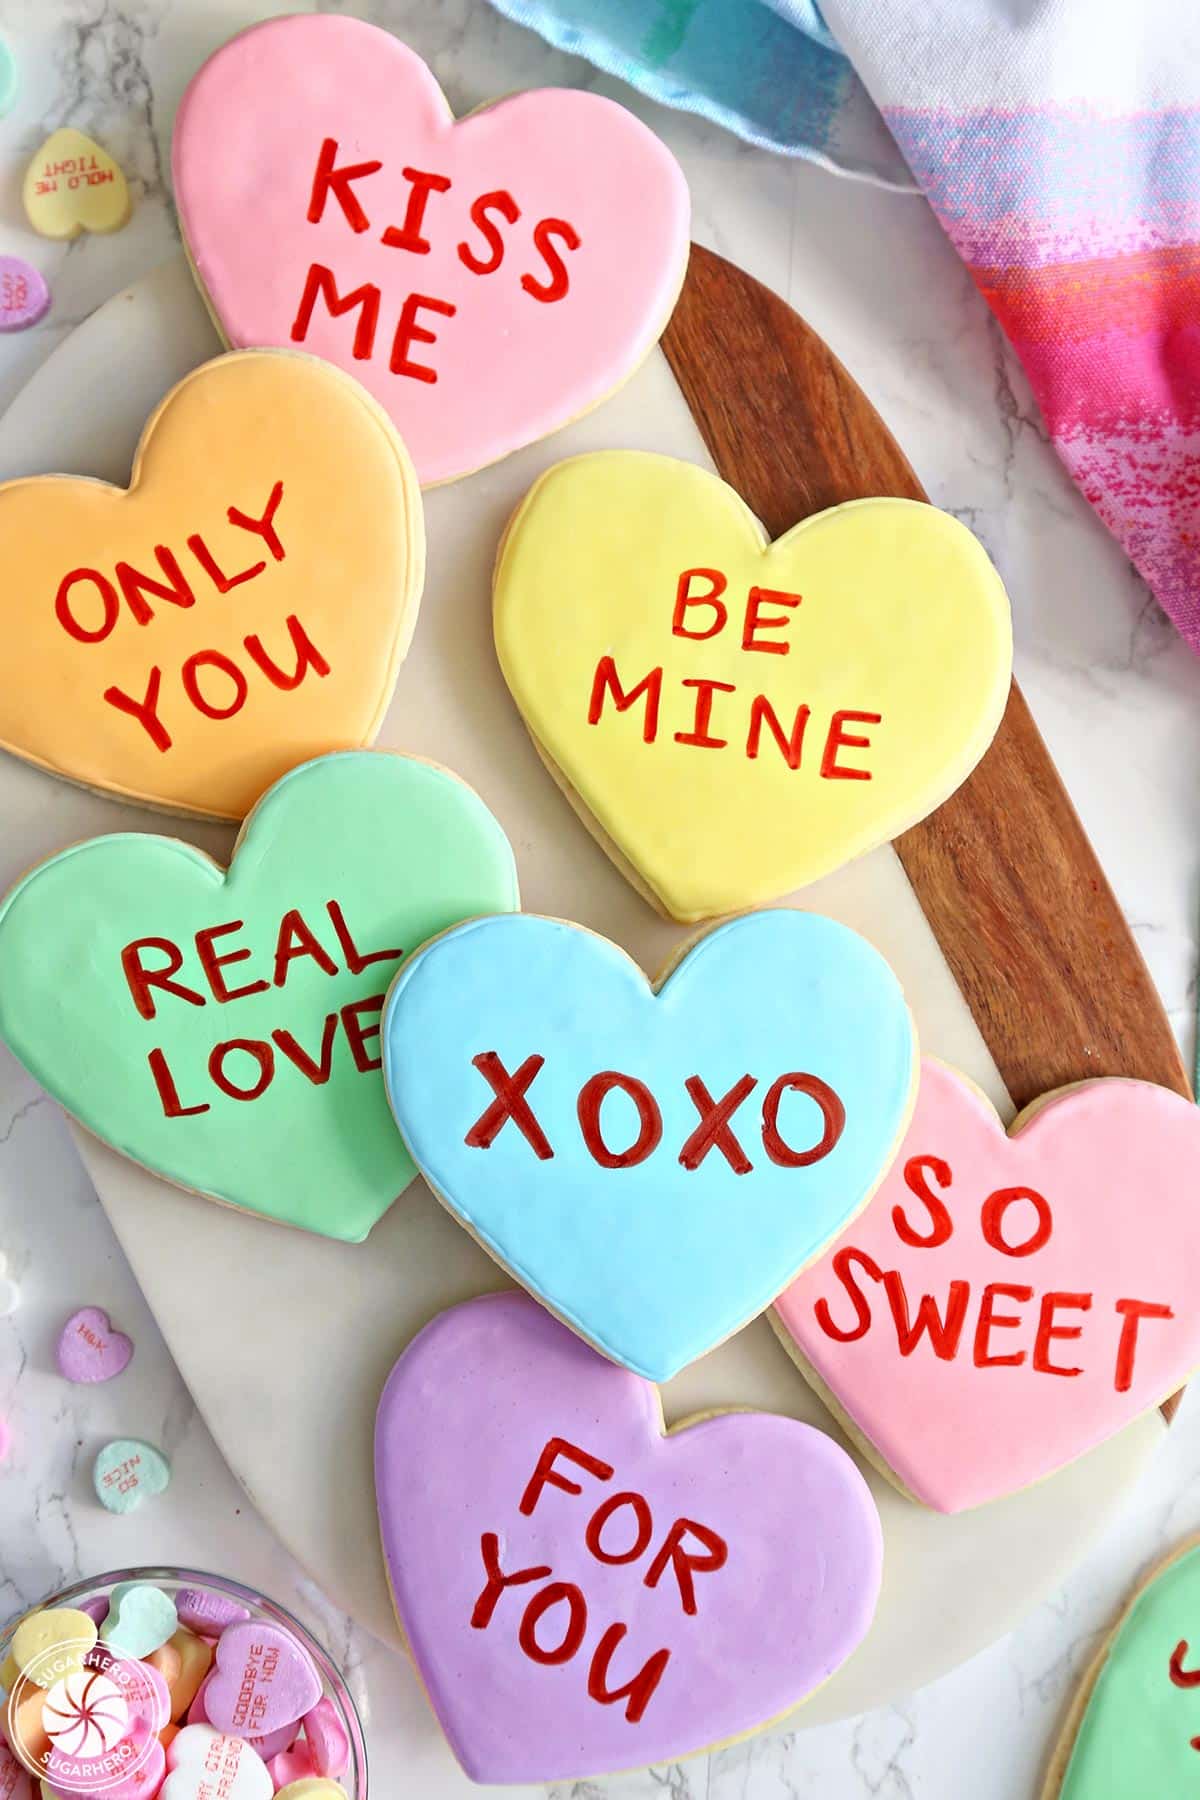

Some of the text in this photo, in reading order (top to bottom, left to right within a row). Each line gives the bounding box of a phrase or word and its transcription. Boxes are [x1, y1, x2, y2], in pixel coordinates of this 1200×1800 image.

[35, 170, 113, 196] HOLD ME
[44, 156, 97, 177] TIGHT
[306, 137, 582, 304] KISS
[290, 263, 457, 385] ME
[54, 480, 286, 644] ONLY
[671, 568, 802, 656] BE
[103, 614, 331, 753] YOU
[588, 655, 882, 781] MINE
[121, 899, 404, 1020] REAL
[148, 994, 385, 1117] LOVE
[466, 1053, 846, 1174] XOXO
[891, 1154, 1053, 1258] SO
[813, 1246, 1175, 1393] SWEET
[103, 1456, 140, 1487] NICE
[519, 1437, 728, 1616] FOR
[232, 1644, 263, 1727] GOODBYE
[470, 1532, 671, 1723] YOU
[248, 1695, 269, 1730] FOR
[260, 1647, 281, 1683] NOW
[216, 1739, 243, 1799] FRIEND
